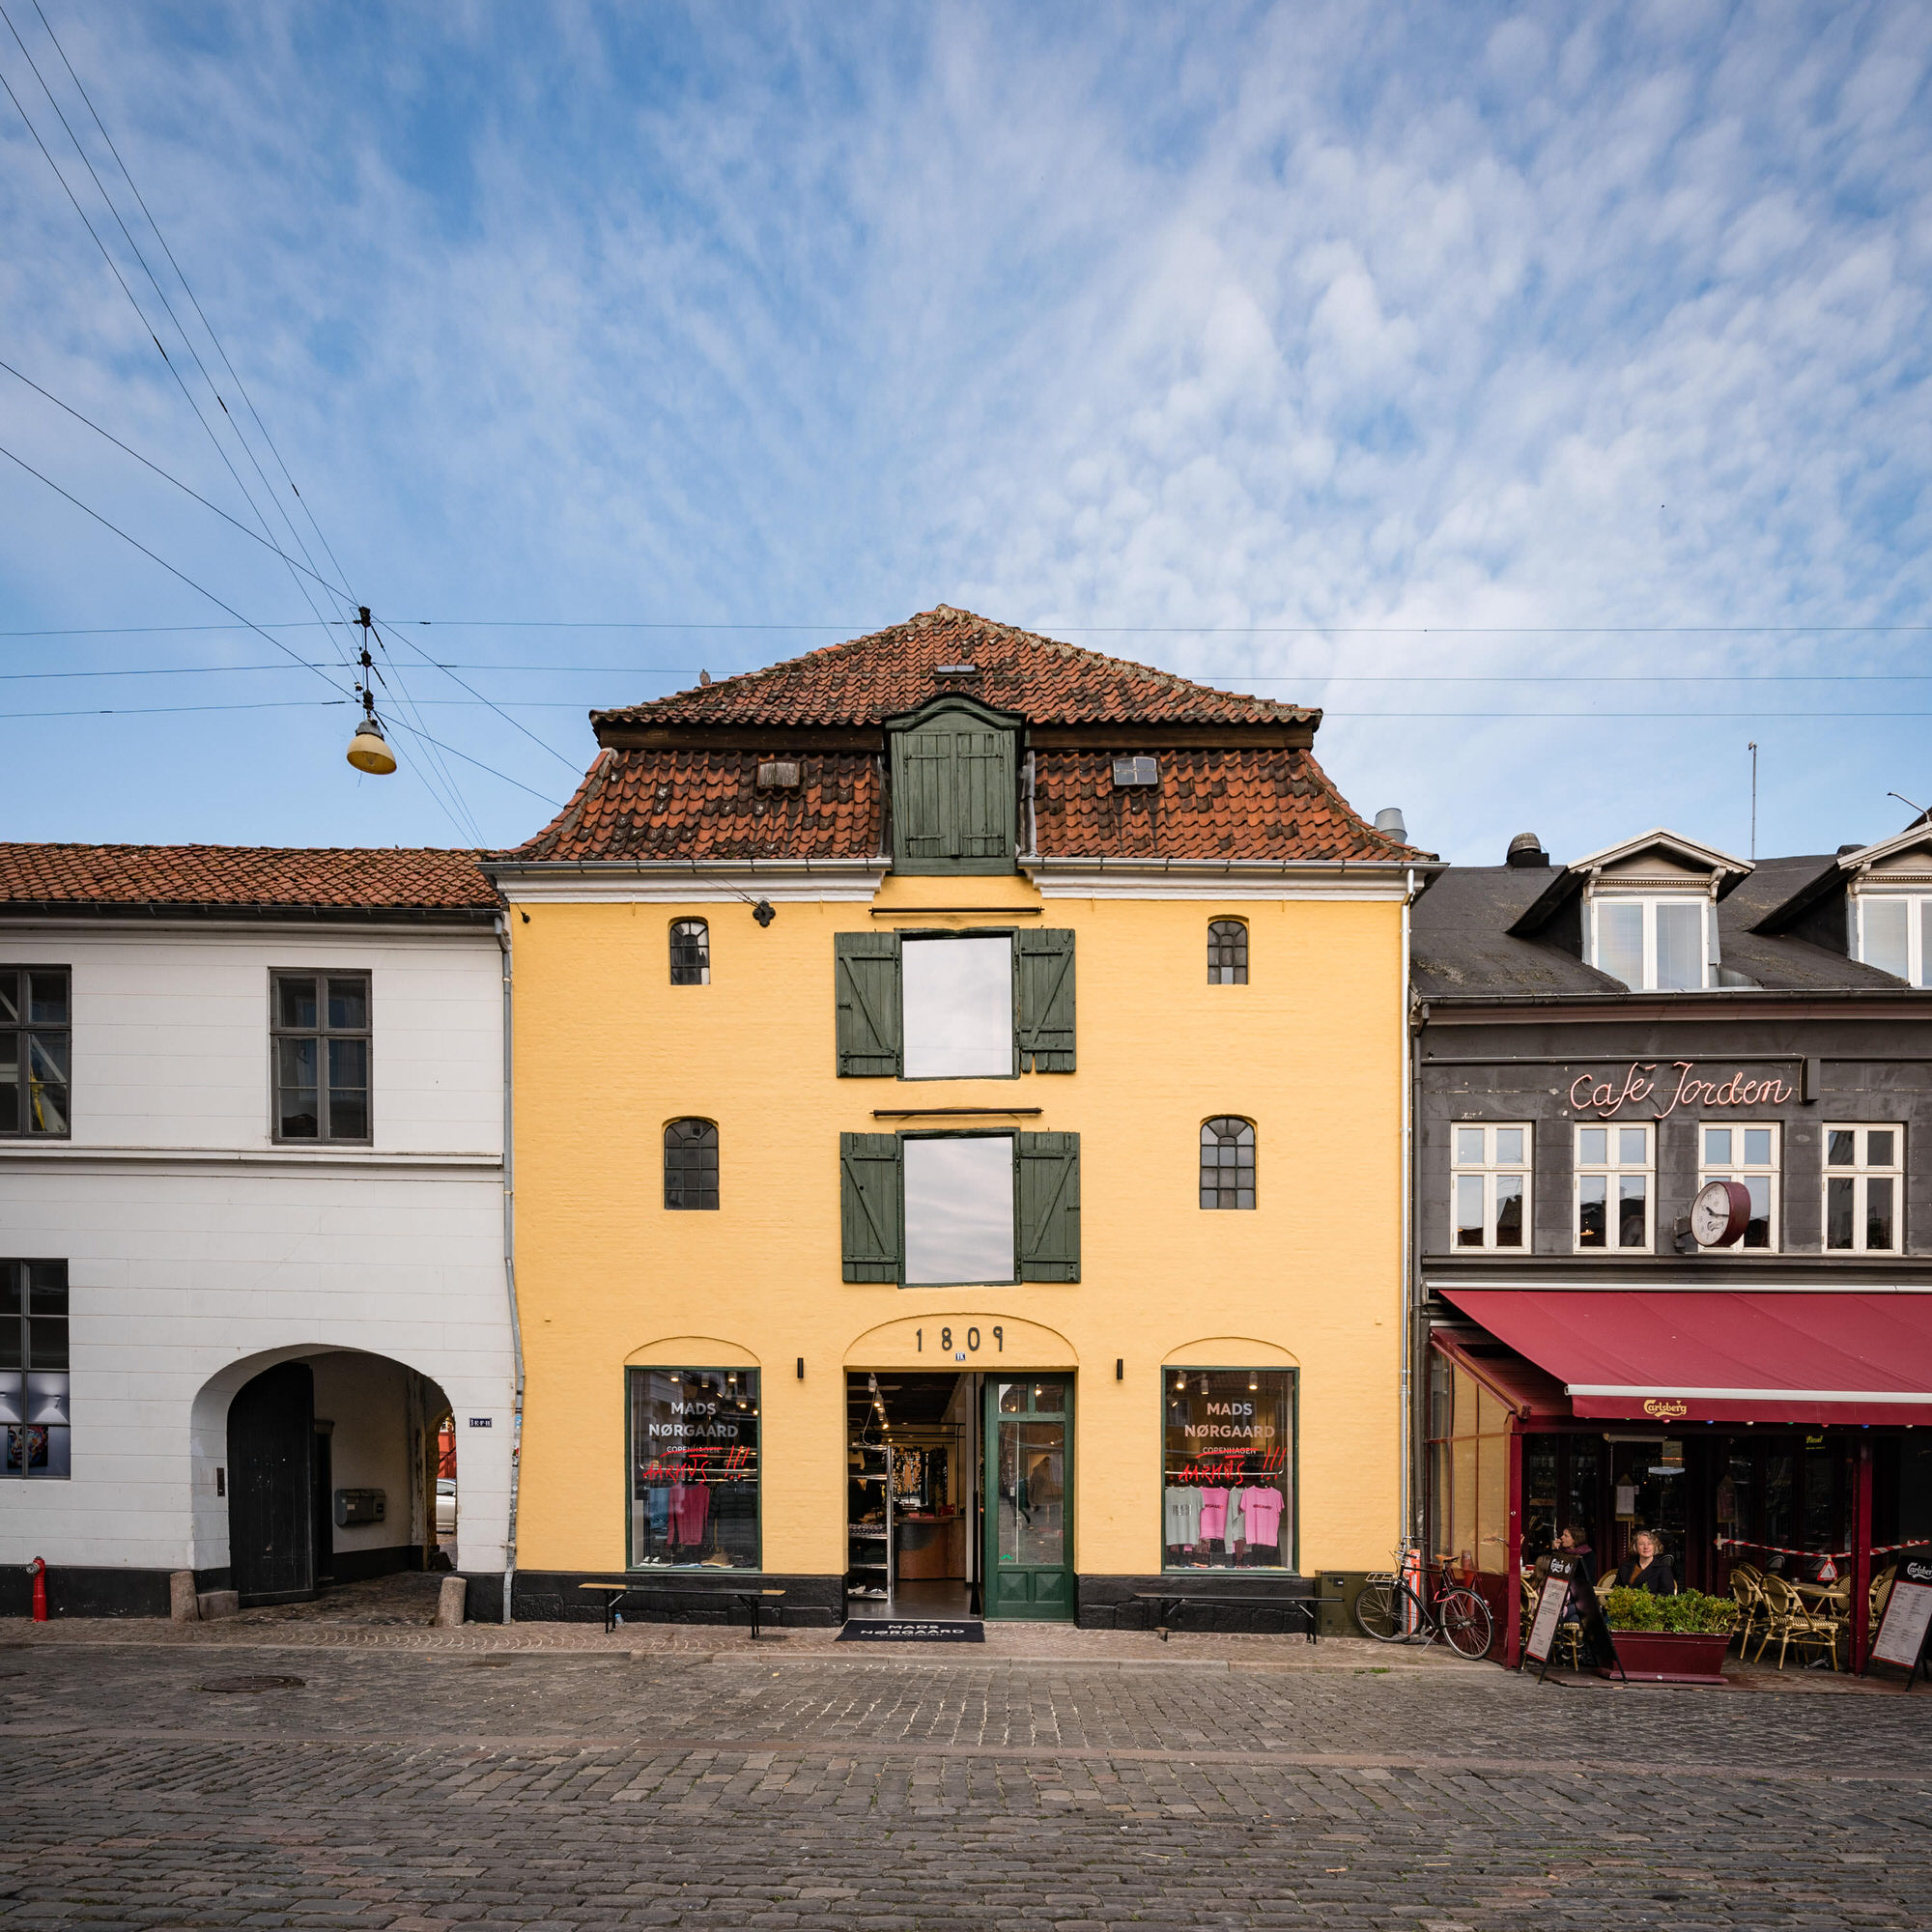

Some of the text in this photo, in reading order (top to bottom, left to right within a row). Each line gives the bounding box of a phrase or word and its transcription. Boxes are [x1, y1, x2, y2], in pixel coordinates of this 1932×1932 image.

[1570, 1062, 1792, 1119] Café Jorden
[916, 1325, 1004, 1352] 1809
[670, 1402, 717, 1415] MADS
[1207, 1403, 1253, 1416] MADS
[1643, 1399, 1688, 1418] Carlsberg
[648, 1423, 739, 1437] NØRGAARD
[1184, 1424, 1275, 1438] NØRGAARD
[1202, 1446, 1257, 1455] COPENHAGEN
